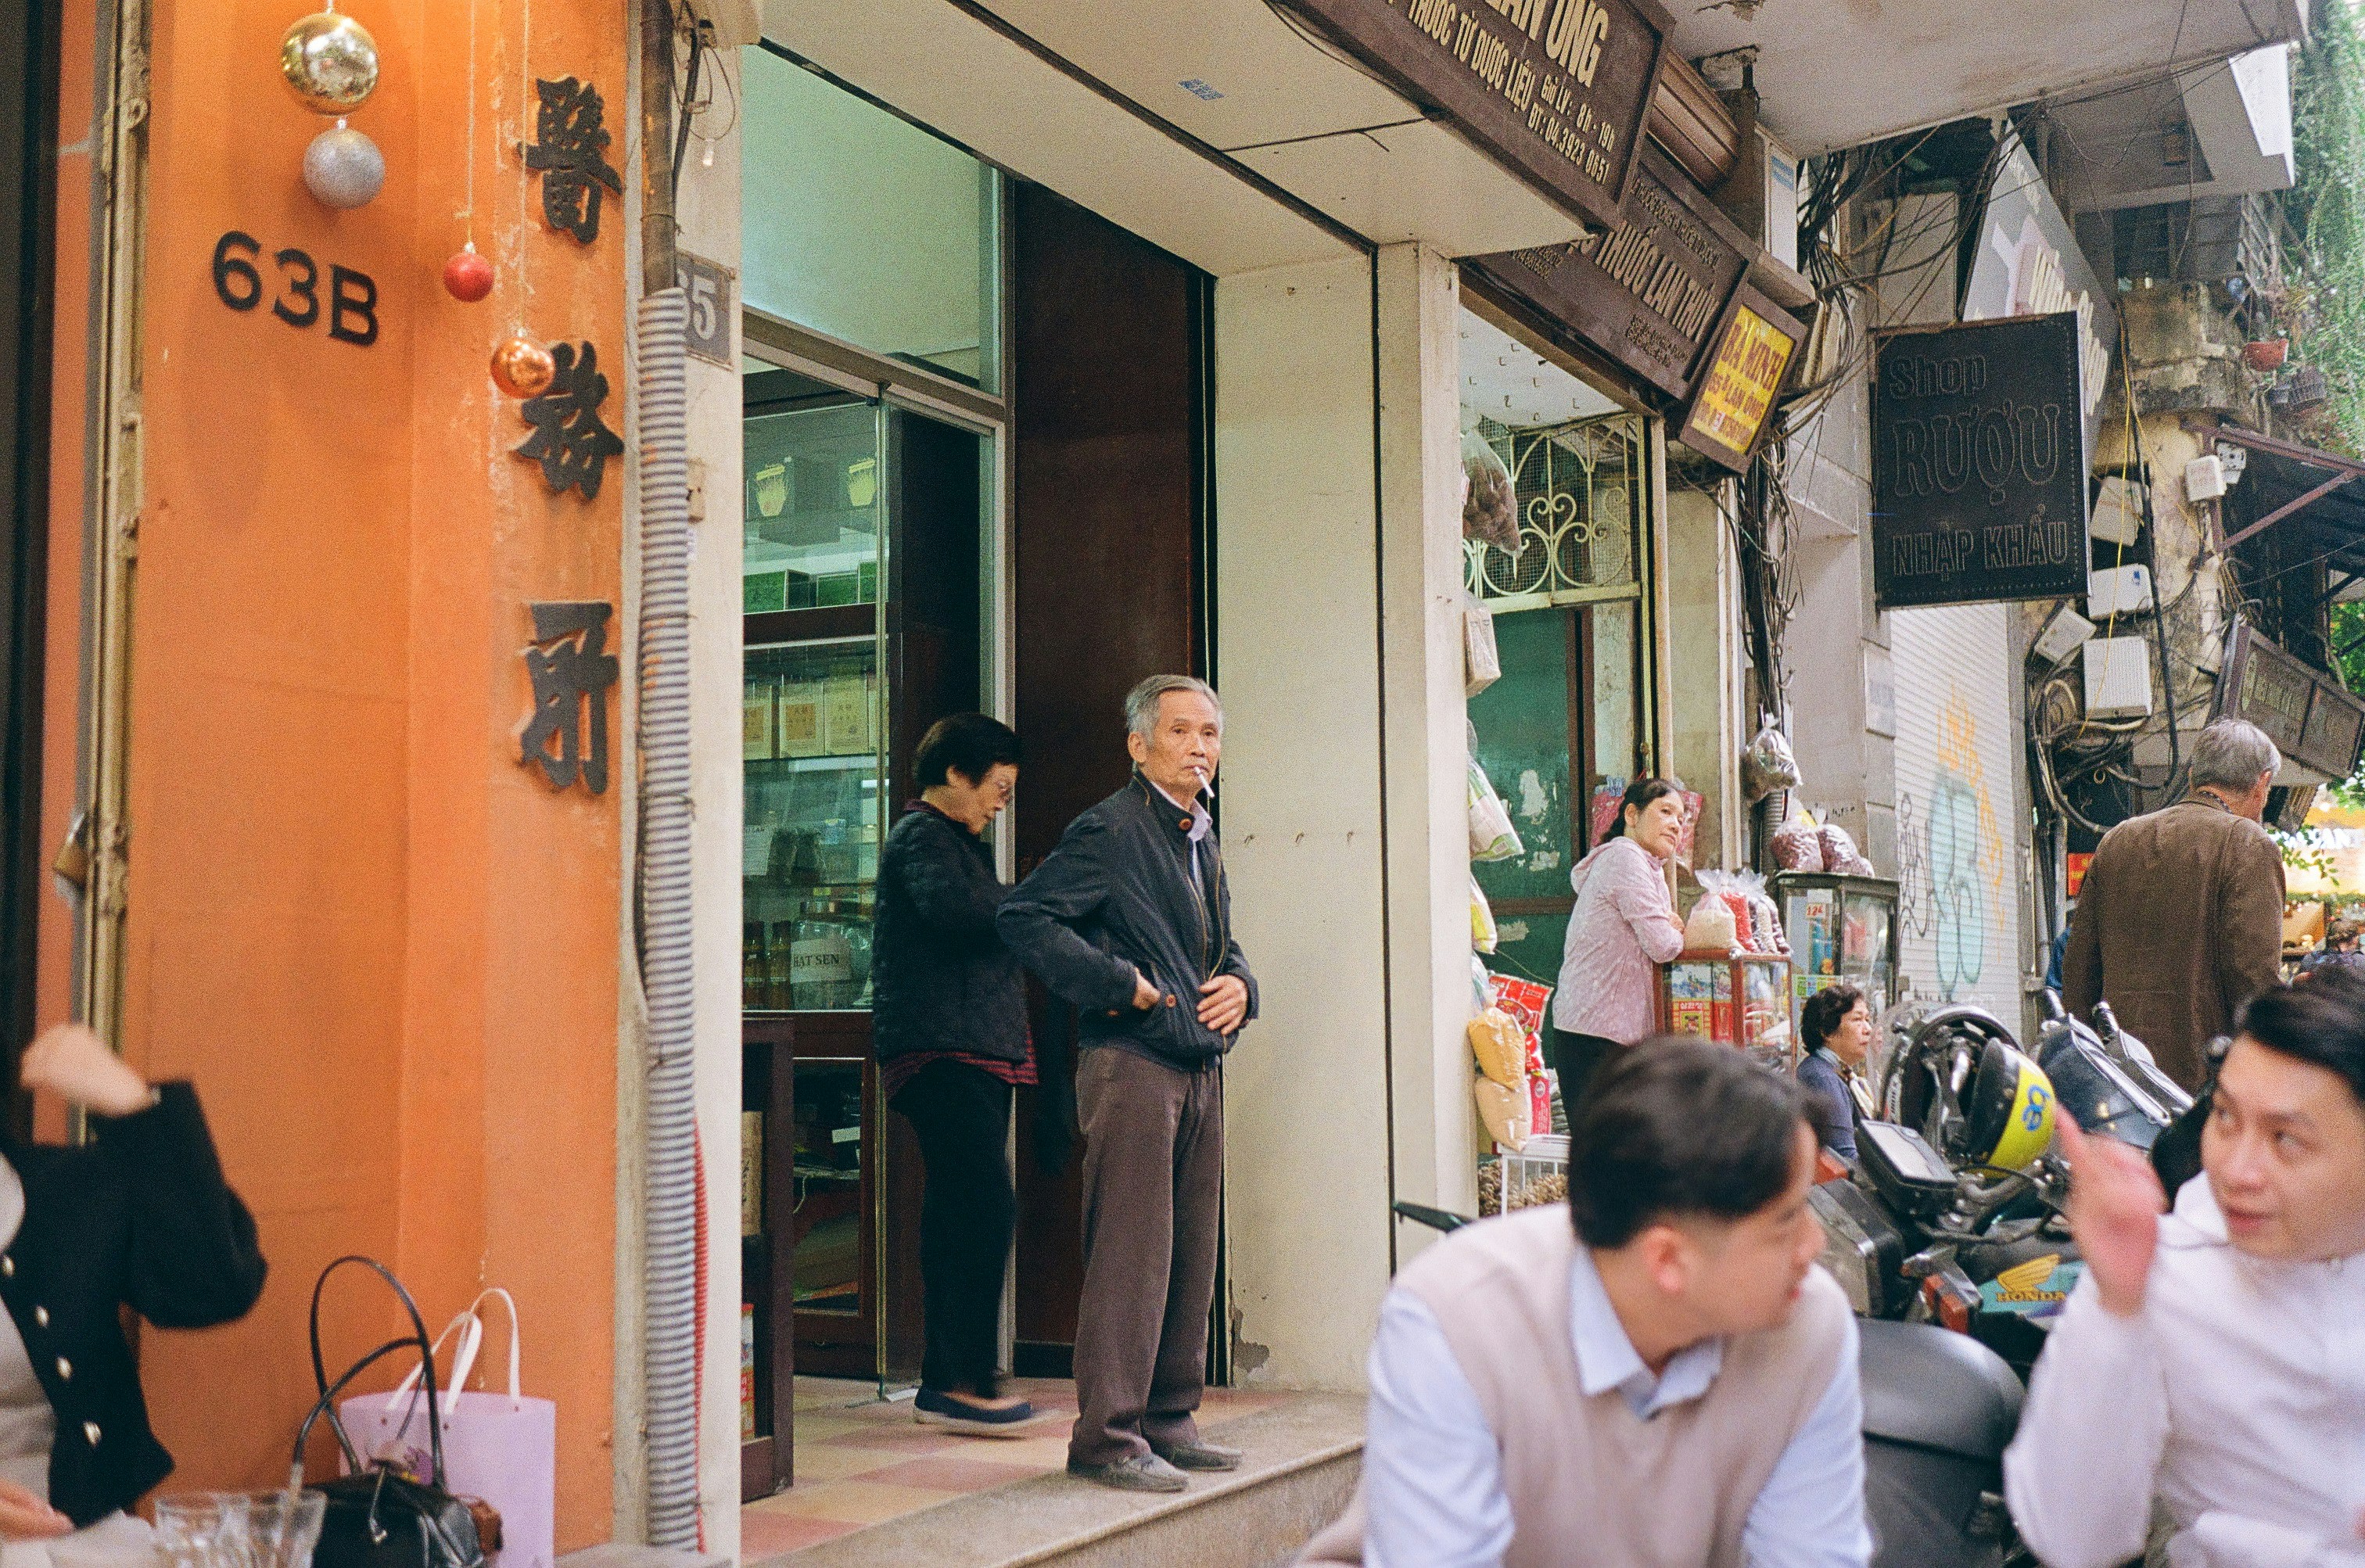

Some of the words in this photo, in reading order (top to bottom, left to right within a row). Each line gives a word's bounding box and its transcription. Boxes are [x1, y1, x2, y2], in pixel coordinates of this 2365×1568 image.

[1453, 9, 1479, 62] TỪ
[1503, 57, 1536, 112] LIỆU
[1545, 117, 1585, 166] 04.3923
[1585, 149, 1610, 185] 0651
[1577, 102, 1592, 133] 8h
[1598, 121, 1615, 152] 19h
[211, 230, 379, 346] 63B
[676, 268, 717, 339] 5
[1642, 254, 1688, 321] LAN
[1739, 335, 1784, 391] MINH
[1889, 354, 1986, 399] Shop
[1892, 400, 2061, 506] RƯỢU
[1892, 520, 1974, 583] NHẬP
[1983, 503, 2068, 572] KHẨU
[1995, 1290, 2067, 1303] HONDA
